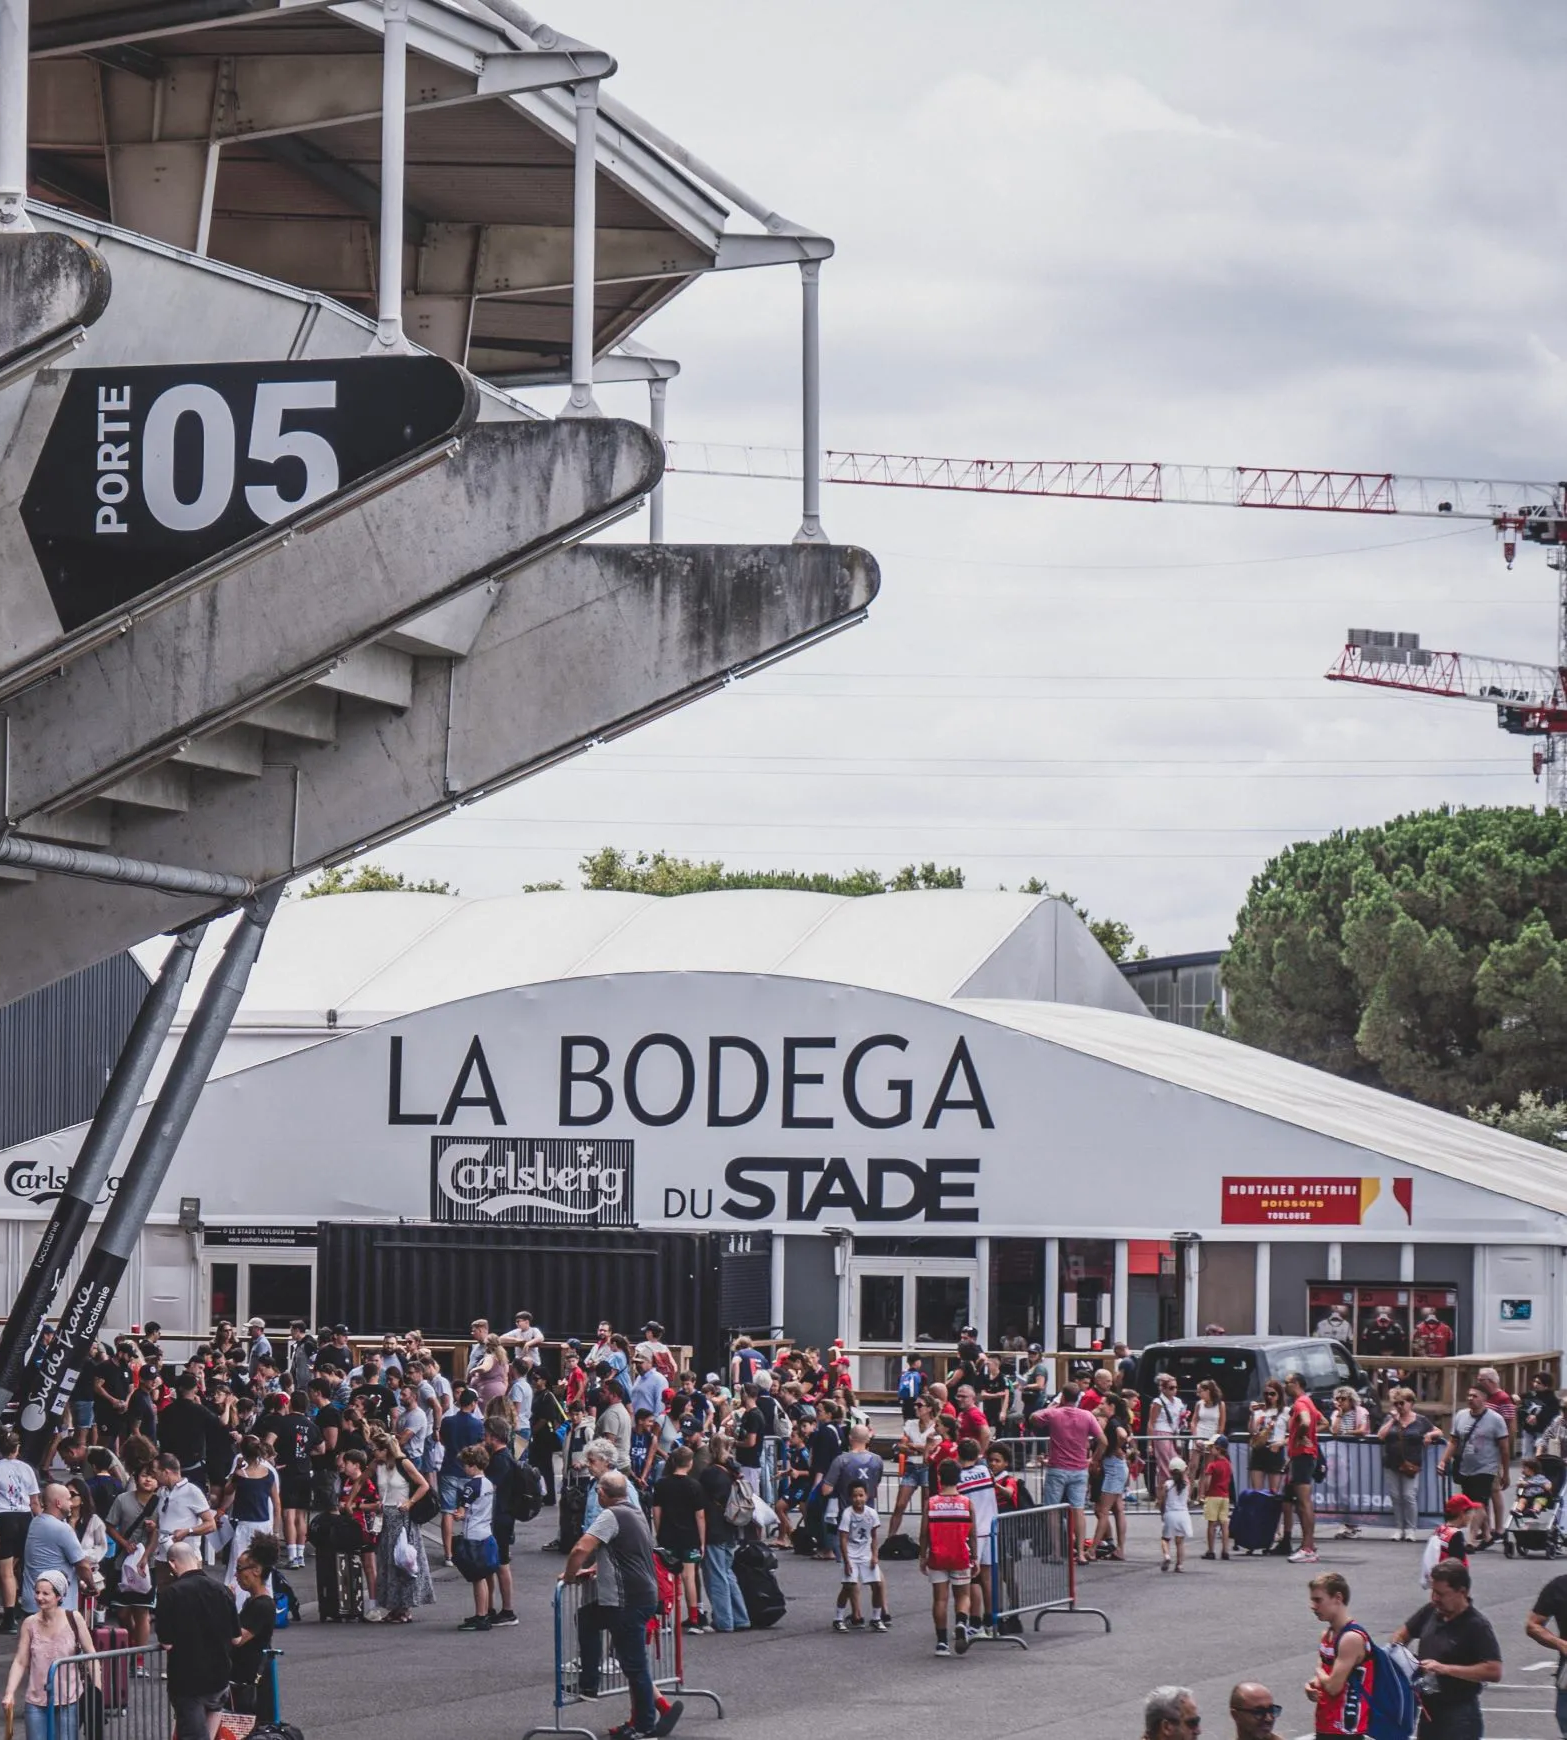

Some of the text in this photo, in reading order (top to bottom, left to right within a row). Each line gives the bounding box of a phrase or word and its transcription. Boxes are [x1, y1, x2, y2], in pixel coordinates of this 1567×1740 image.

[95, 385, 131, 533] PORTE
[142, 381, 339, 531] 05
[388, 1033, 995, 1129] LA BODEGA
[438, 1143, 626, 1206] Carlsberg
[664, 1156, 980, 1222] DU STADE
[1229, 1185, 1357, 1196] MONTANER PIETRINI
[1261, 1200, 1324, 1208] BOISSONS
[35, 1220, 60, 1268] l'occitanie
[237, 1228, 256, 1236] STADE
[258, 1228, 295, 1236] TOULOUSAIN
[1267, 1212, 1311, 1220] TOULOUSE
[55, 1280, 95, 1348] France
[80, 1285, 111, 1340] l'occitanie
